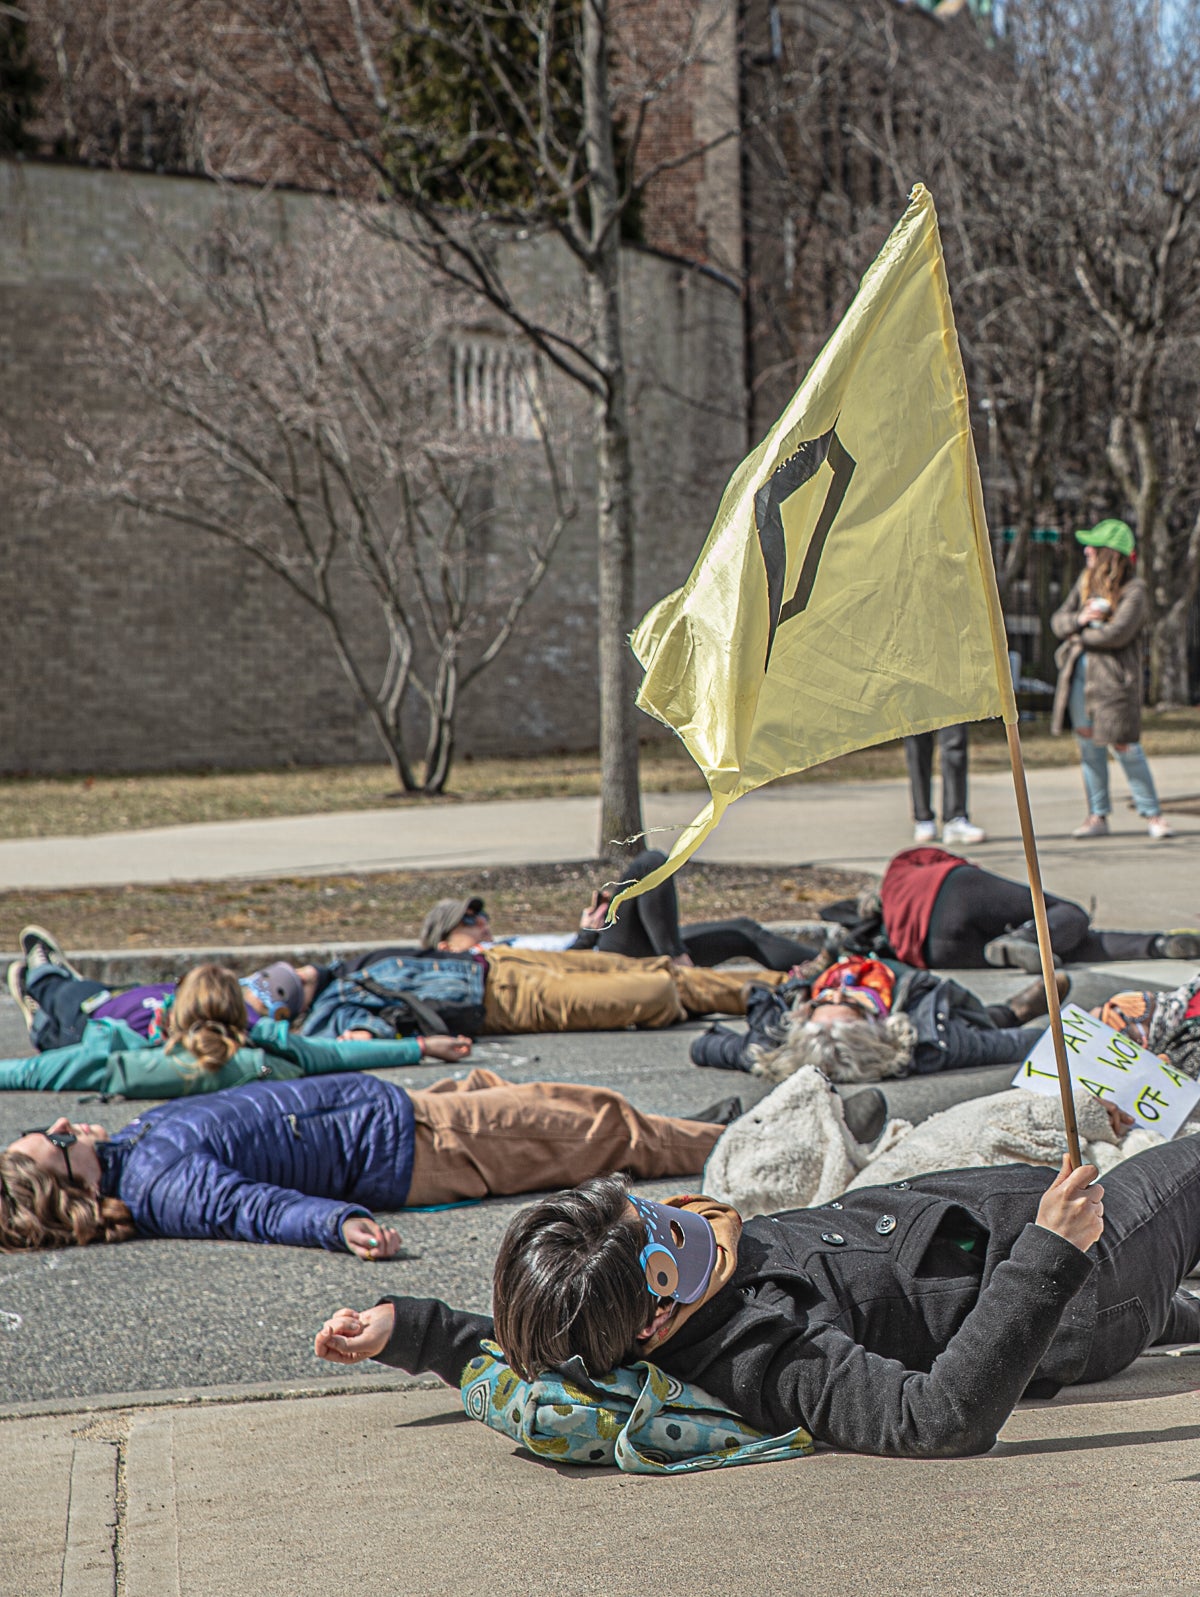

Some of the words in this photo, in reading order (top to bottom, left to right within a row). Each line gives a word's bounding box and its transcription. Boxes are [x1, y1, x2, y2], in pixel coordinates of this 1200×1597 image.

[1062, 1010, 1101, 1054] AM
[1078, 1077, 1115, 1099] A
[1136, 1085, 1169, 1121] OF
